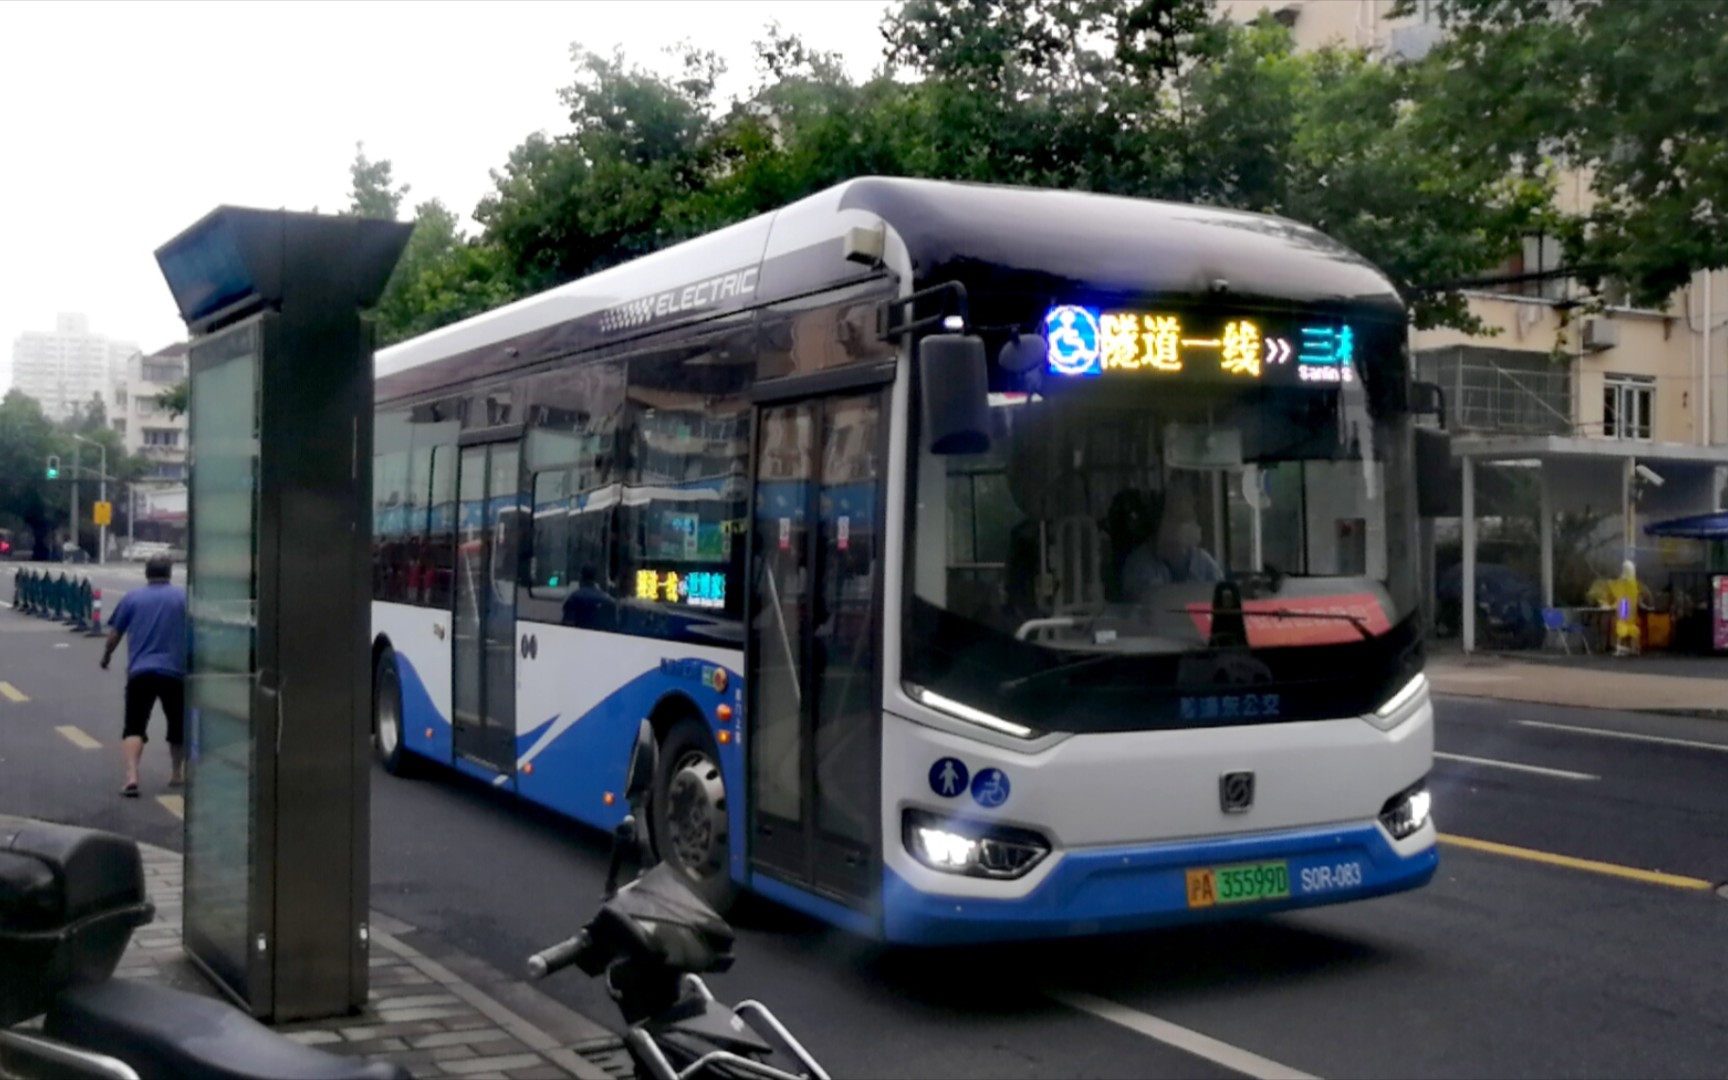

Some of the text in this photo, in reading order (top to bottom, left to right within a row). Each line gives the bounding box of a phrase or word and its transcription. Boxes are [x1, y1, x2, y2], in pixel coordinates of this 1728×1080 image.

[655, 266, 759, 317] ELECTRIC
[1099, 312, 1261, 377] 隧道一线
